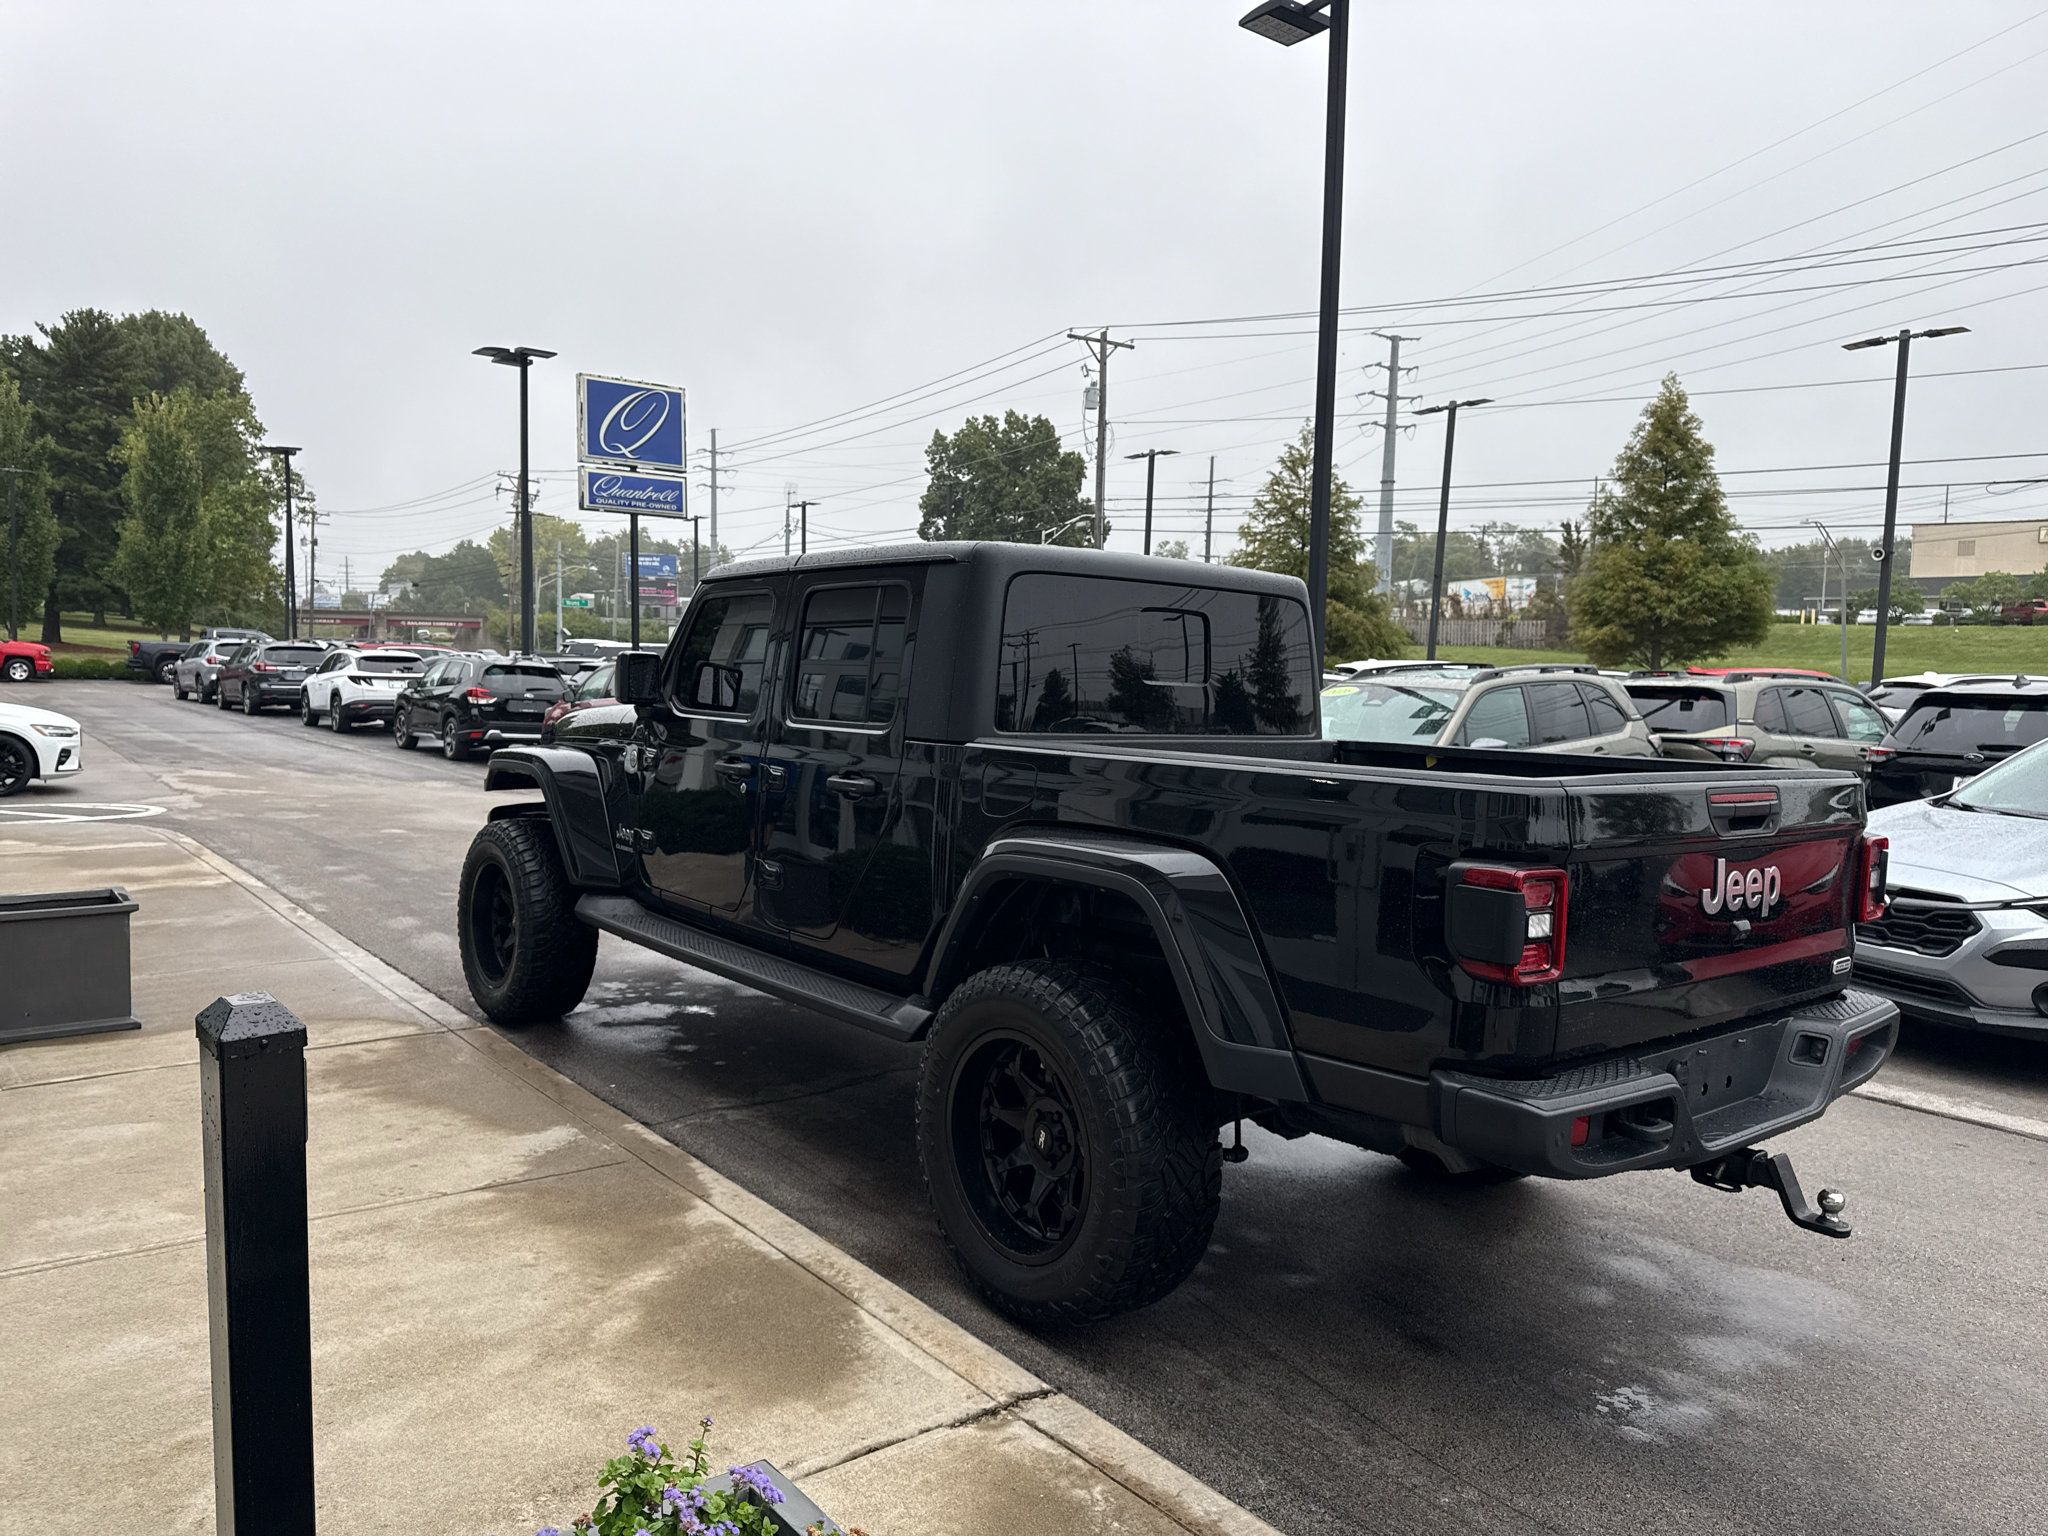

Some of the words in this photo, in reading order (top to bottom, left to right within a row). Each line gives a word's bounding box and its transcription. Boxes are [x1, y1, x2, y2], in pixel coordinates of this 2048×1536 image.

[599, 390, 670, 459] Q
[592, 475, 680, 502] Quantrell
[595, 498, 630, 507] QUALITY
[631, 501, 677, 511] PRE-OWNED
[1702, 857, 1781, 918] Jeep
